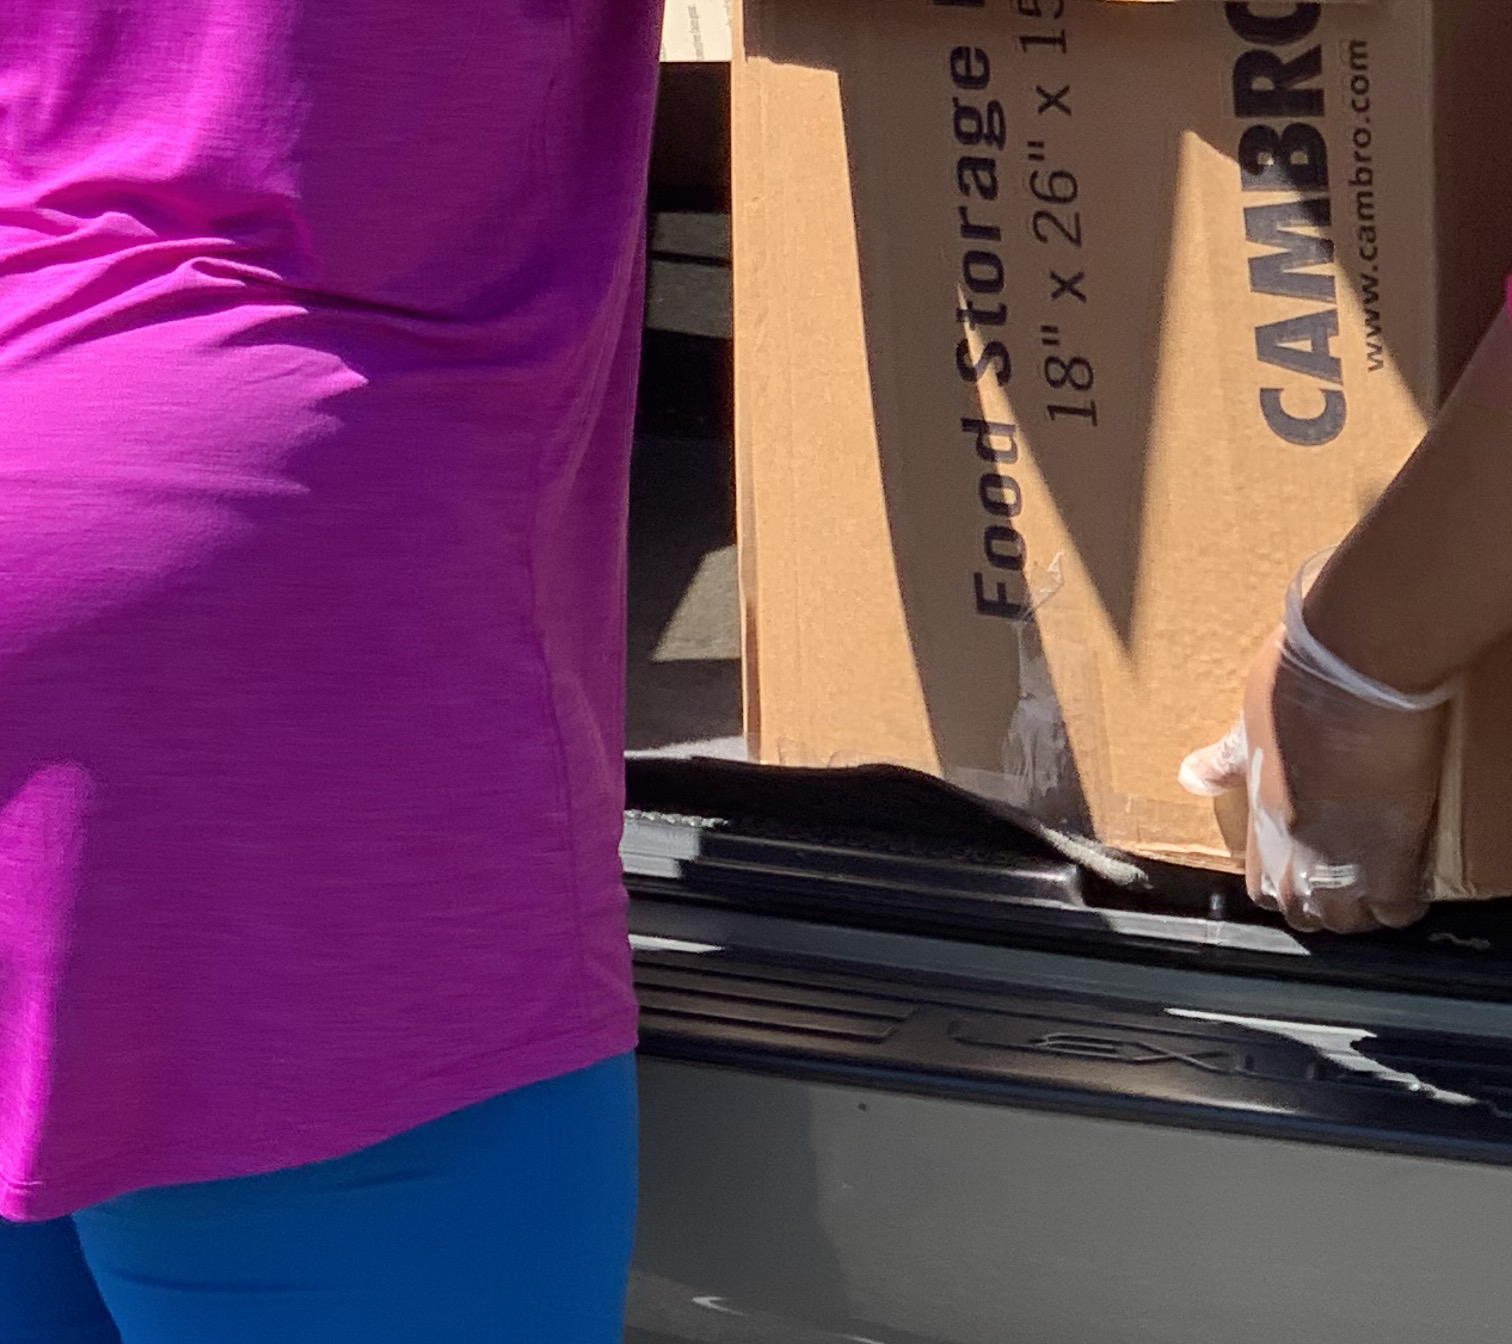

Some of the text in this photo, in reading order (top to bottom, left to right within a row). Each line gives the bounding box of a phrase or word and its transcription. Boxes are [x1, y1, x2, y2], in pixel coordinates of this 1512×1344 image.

[1036, 84, 1072, 117] x
[949, 45, 1013, 387] Storage
[1028, 140, 1082, 249] 26"
[1347, 39, 1385, 373] www.cambro.com
[1049, 270, 1087, 304] x
[1040, 325, 1098, 428] 18"
[960, 417, 1033, 621] Food
